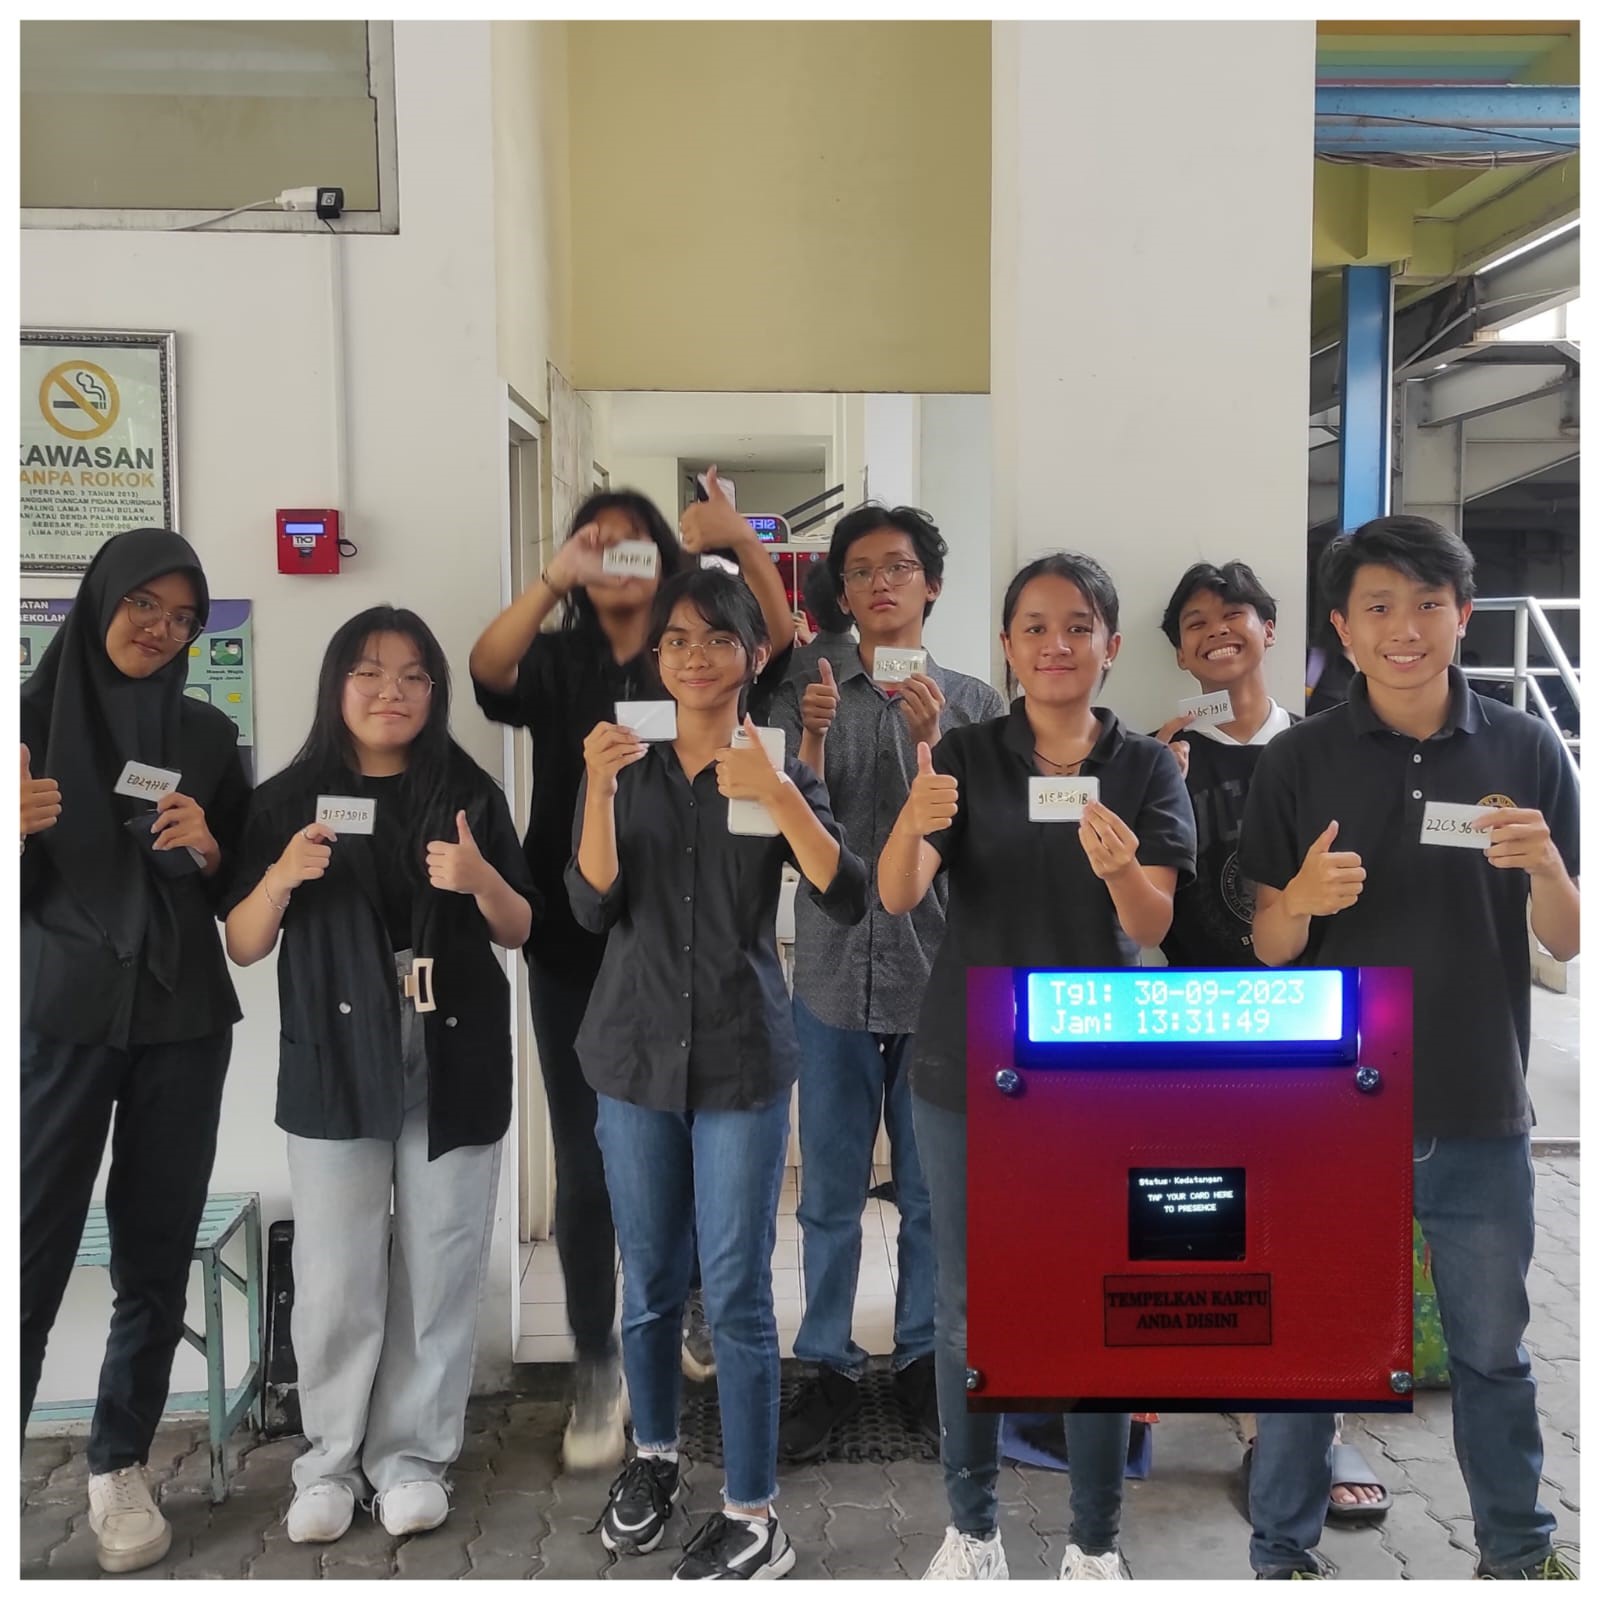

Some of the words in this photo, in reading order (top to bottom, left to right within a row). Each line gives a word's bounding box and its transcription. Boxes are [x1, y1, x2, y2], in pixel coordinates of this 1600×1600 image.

[80, 471, 156, 488] ROKOK
[88, 490, 115, 498] TAHUN
[60, 513, 88, 521] DENDA
[90, 514, 120, 522] PALING
[32, 521, 72, 529] SEBESAR
[54, 529, 82, 537] PULUH
[38, 553, 87, 561] KESEHATAN
[1051, 980, 1112, 1006] Tgl:
[1135, 979, 1305, 1005] 30-09-2023
[1051, 1009, 1112, 1034] Jam:
[1137, 1009, 1270, 1034] 13:31:49
[1138, 1177, 1172, 1187] Status:
[1174, 1175, 1223, 1185] Kedatangan
[1147, 1193, 1163, 1202] TAP
[1166, 1192, 1187, 1201] YOUR
[1189, 1191, 1210, 1200] CARD
[1213, 1190, 1234, 1199] HERE
[1163, 1205, 1175, 1213] TO
[1178, 1203, 1217, 1212] PRESENCE
[1107, 1291, 1207, 1307] TEMPELKAN
[1211, 1289, 1268, 1307] KARTU
[1136, 1313, 1183, 1329] ANDA
[1186, 1313, 1239, 1328] DISINI
